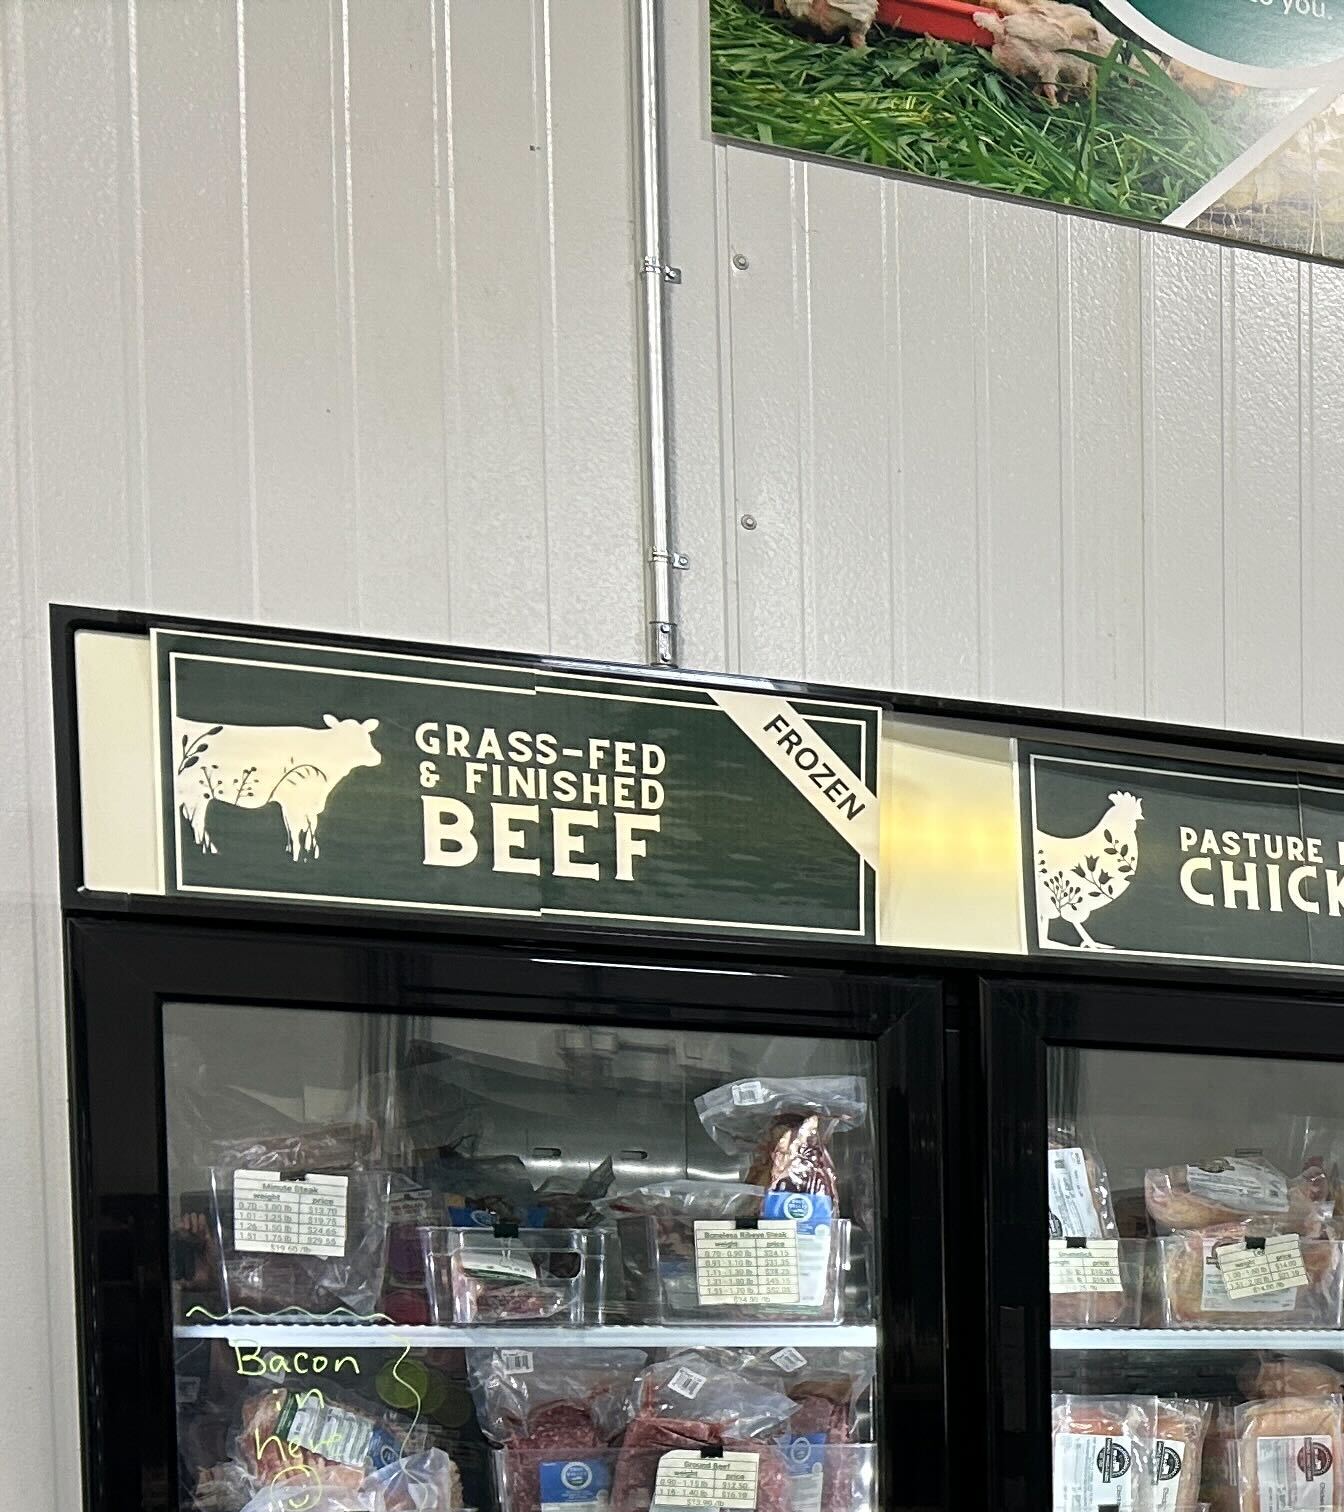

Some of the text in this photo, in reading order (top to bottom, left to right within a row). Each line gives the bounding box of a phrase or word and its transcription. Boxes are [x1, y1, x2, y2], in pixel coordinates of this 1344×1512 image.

[1283, 0, 1333, 20] you.
[415, 721, 666, 775] GRASS-FED
[763, 714, 866, 821] FROZEN
[418, 761, 665, 810] & FINISHED
[421, 797, 662, 881] BEEF
[1179, 826, 1323, 864] PASTURE
[232, 1340, 360, 1377] Bacon
